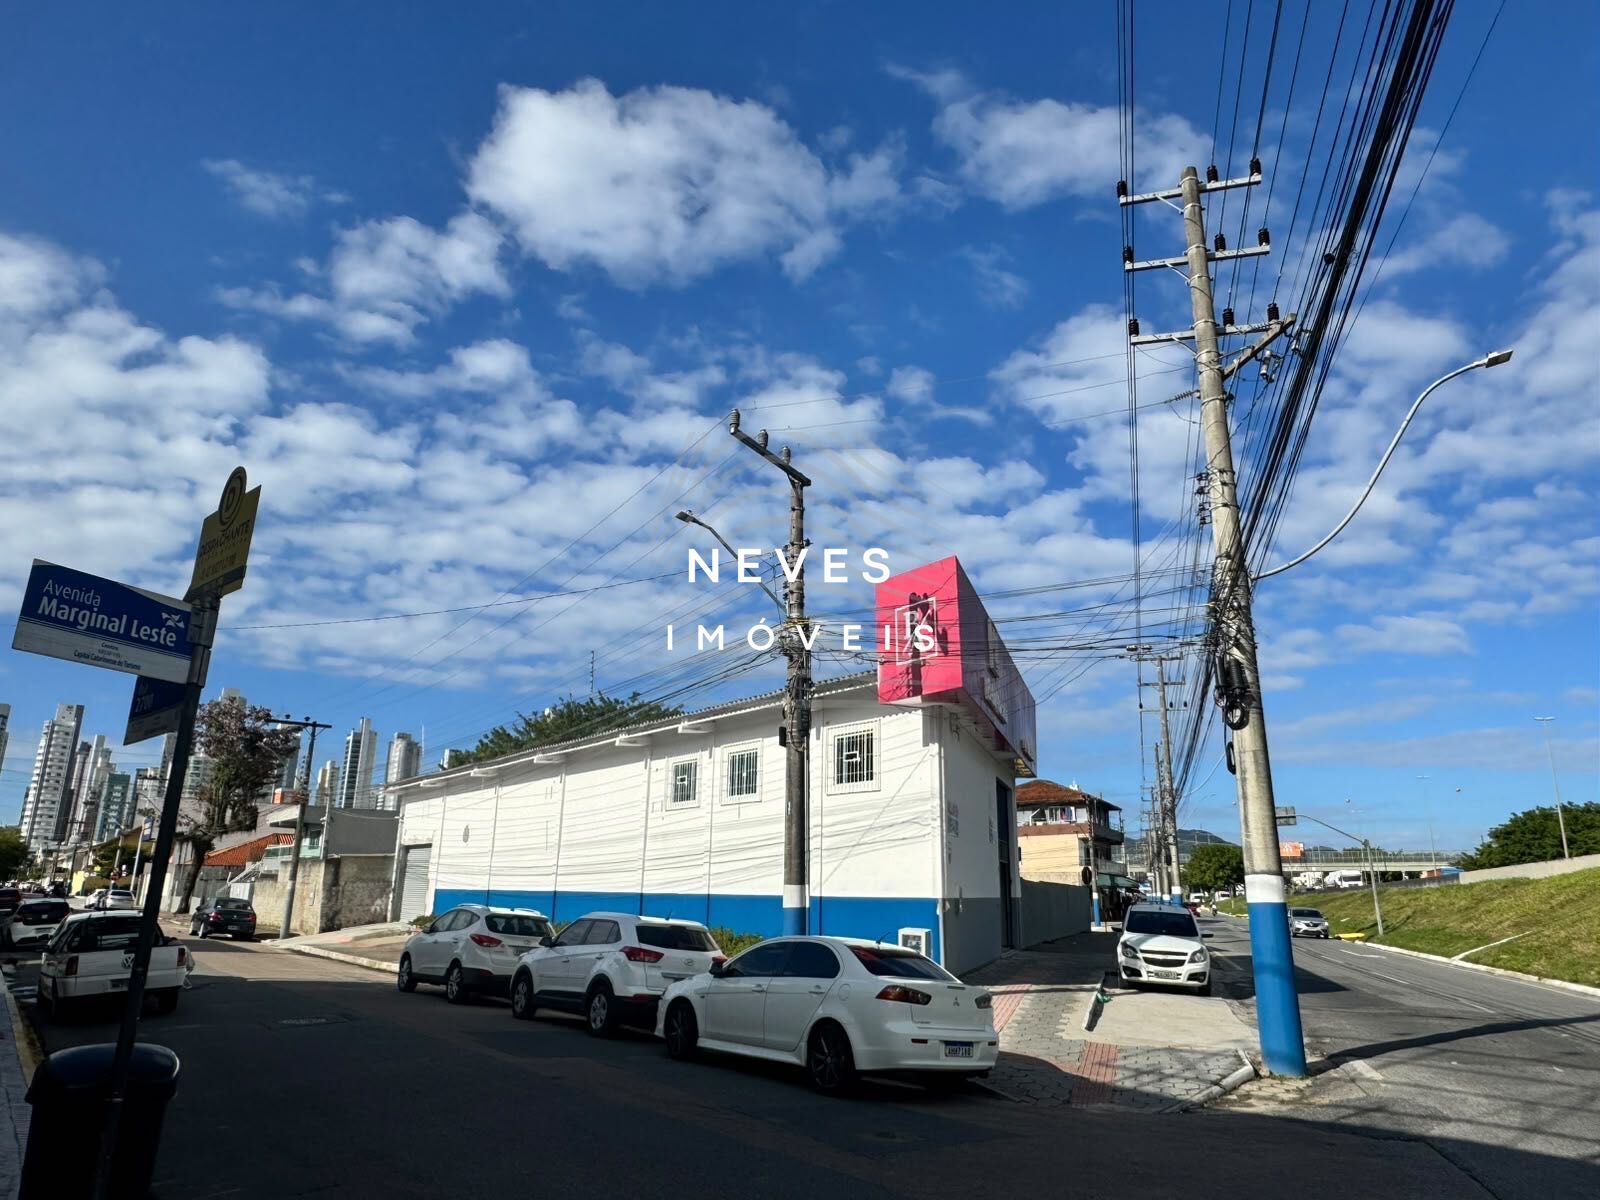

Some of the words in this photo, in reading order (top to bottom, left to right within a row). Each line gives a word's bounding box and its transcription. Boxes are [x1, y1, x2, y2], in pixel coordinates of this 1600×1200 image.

[43, 579, 101, 607] Avenida
[37, 595, 127, 634] Marginal
[130, 619, 177, 647] Leste
